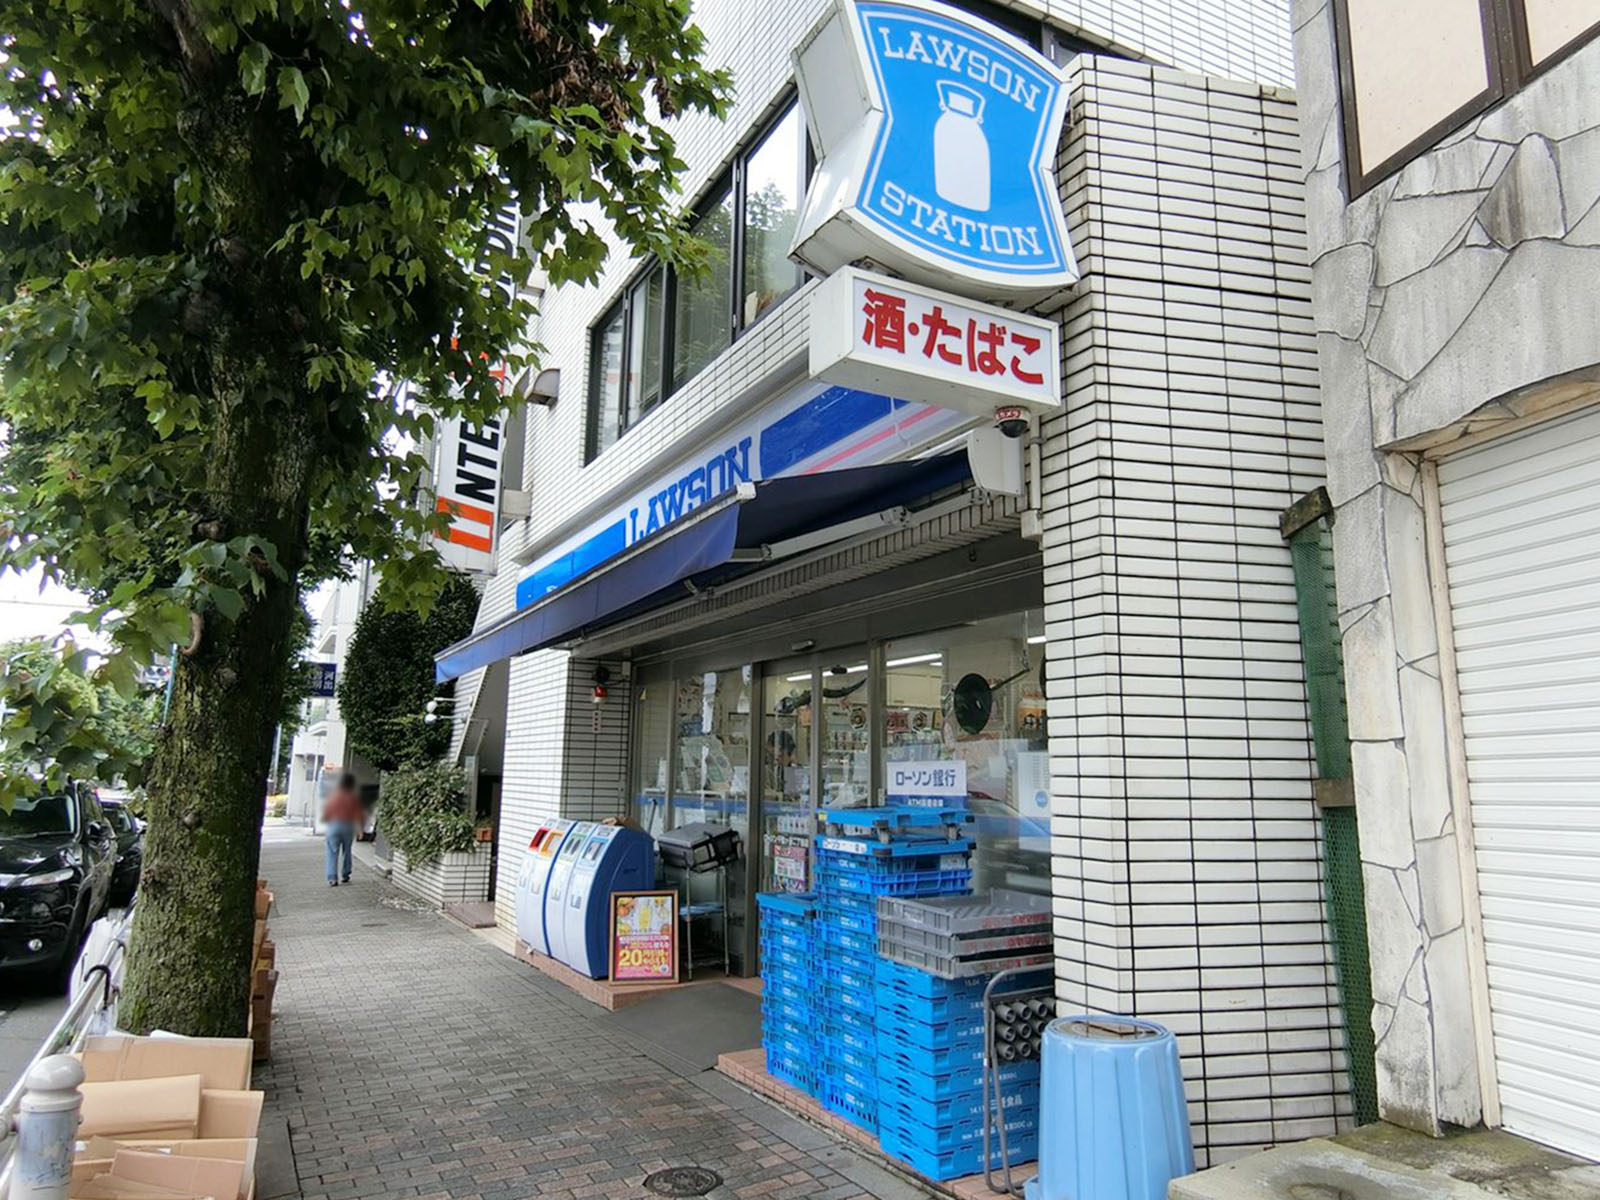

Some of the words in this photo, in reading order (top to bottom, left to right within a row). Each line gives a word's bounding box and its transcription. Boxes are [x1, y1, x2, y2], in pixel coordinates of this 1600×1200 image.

[879, 27, 1041, 112] LAWSON
[880, 181, 1044, 256] STATION
[862, 288, 1044, 385] 酒・たばこ
[629, 436, 752, 546] LAWSON
[895, 769, 957, 787] ローソン銀行
